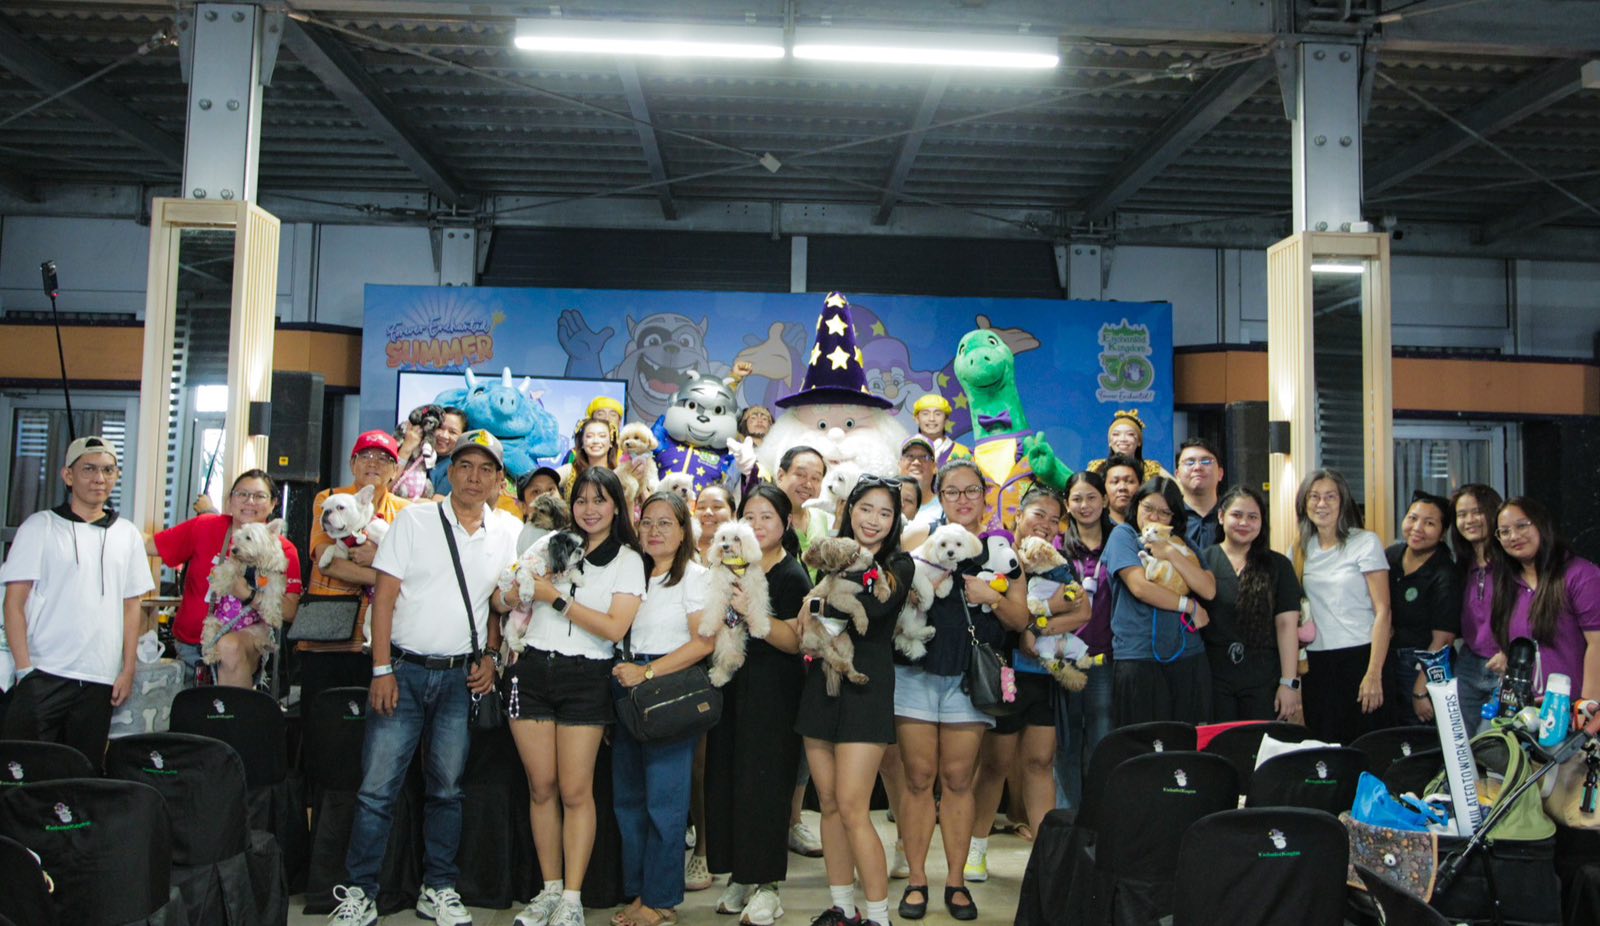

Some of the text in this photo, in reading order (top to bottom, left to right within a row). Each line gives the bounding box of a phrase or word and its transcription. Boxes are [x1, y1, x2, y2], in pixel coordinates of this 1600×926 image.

[385, 334, 493, 368] SUMMER
[1100, 354, 1153, 392] 30
[1445, 694, 1482, 834] MULATED TO WORK WONDERS
